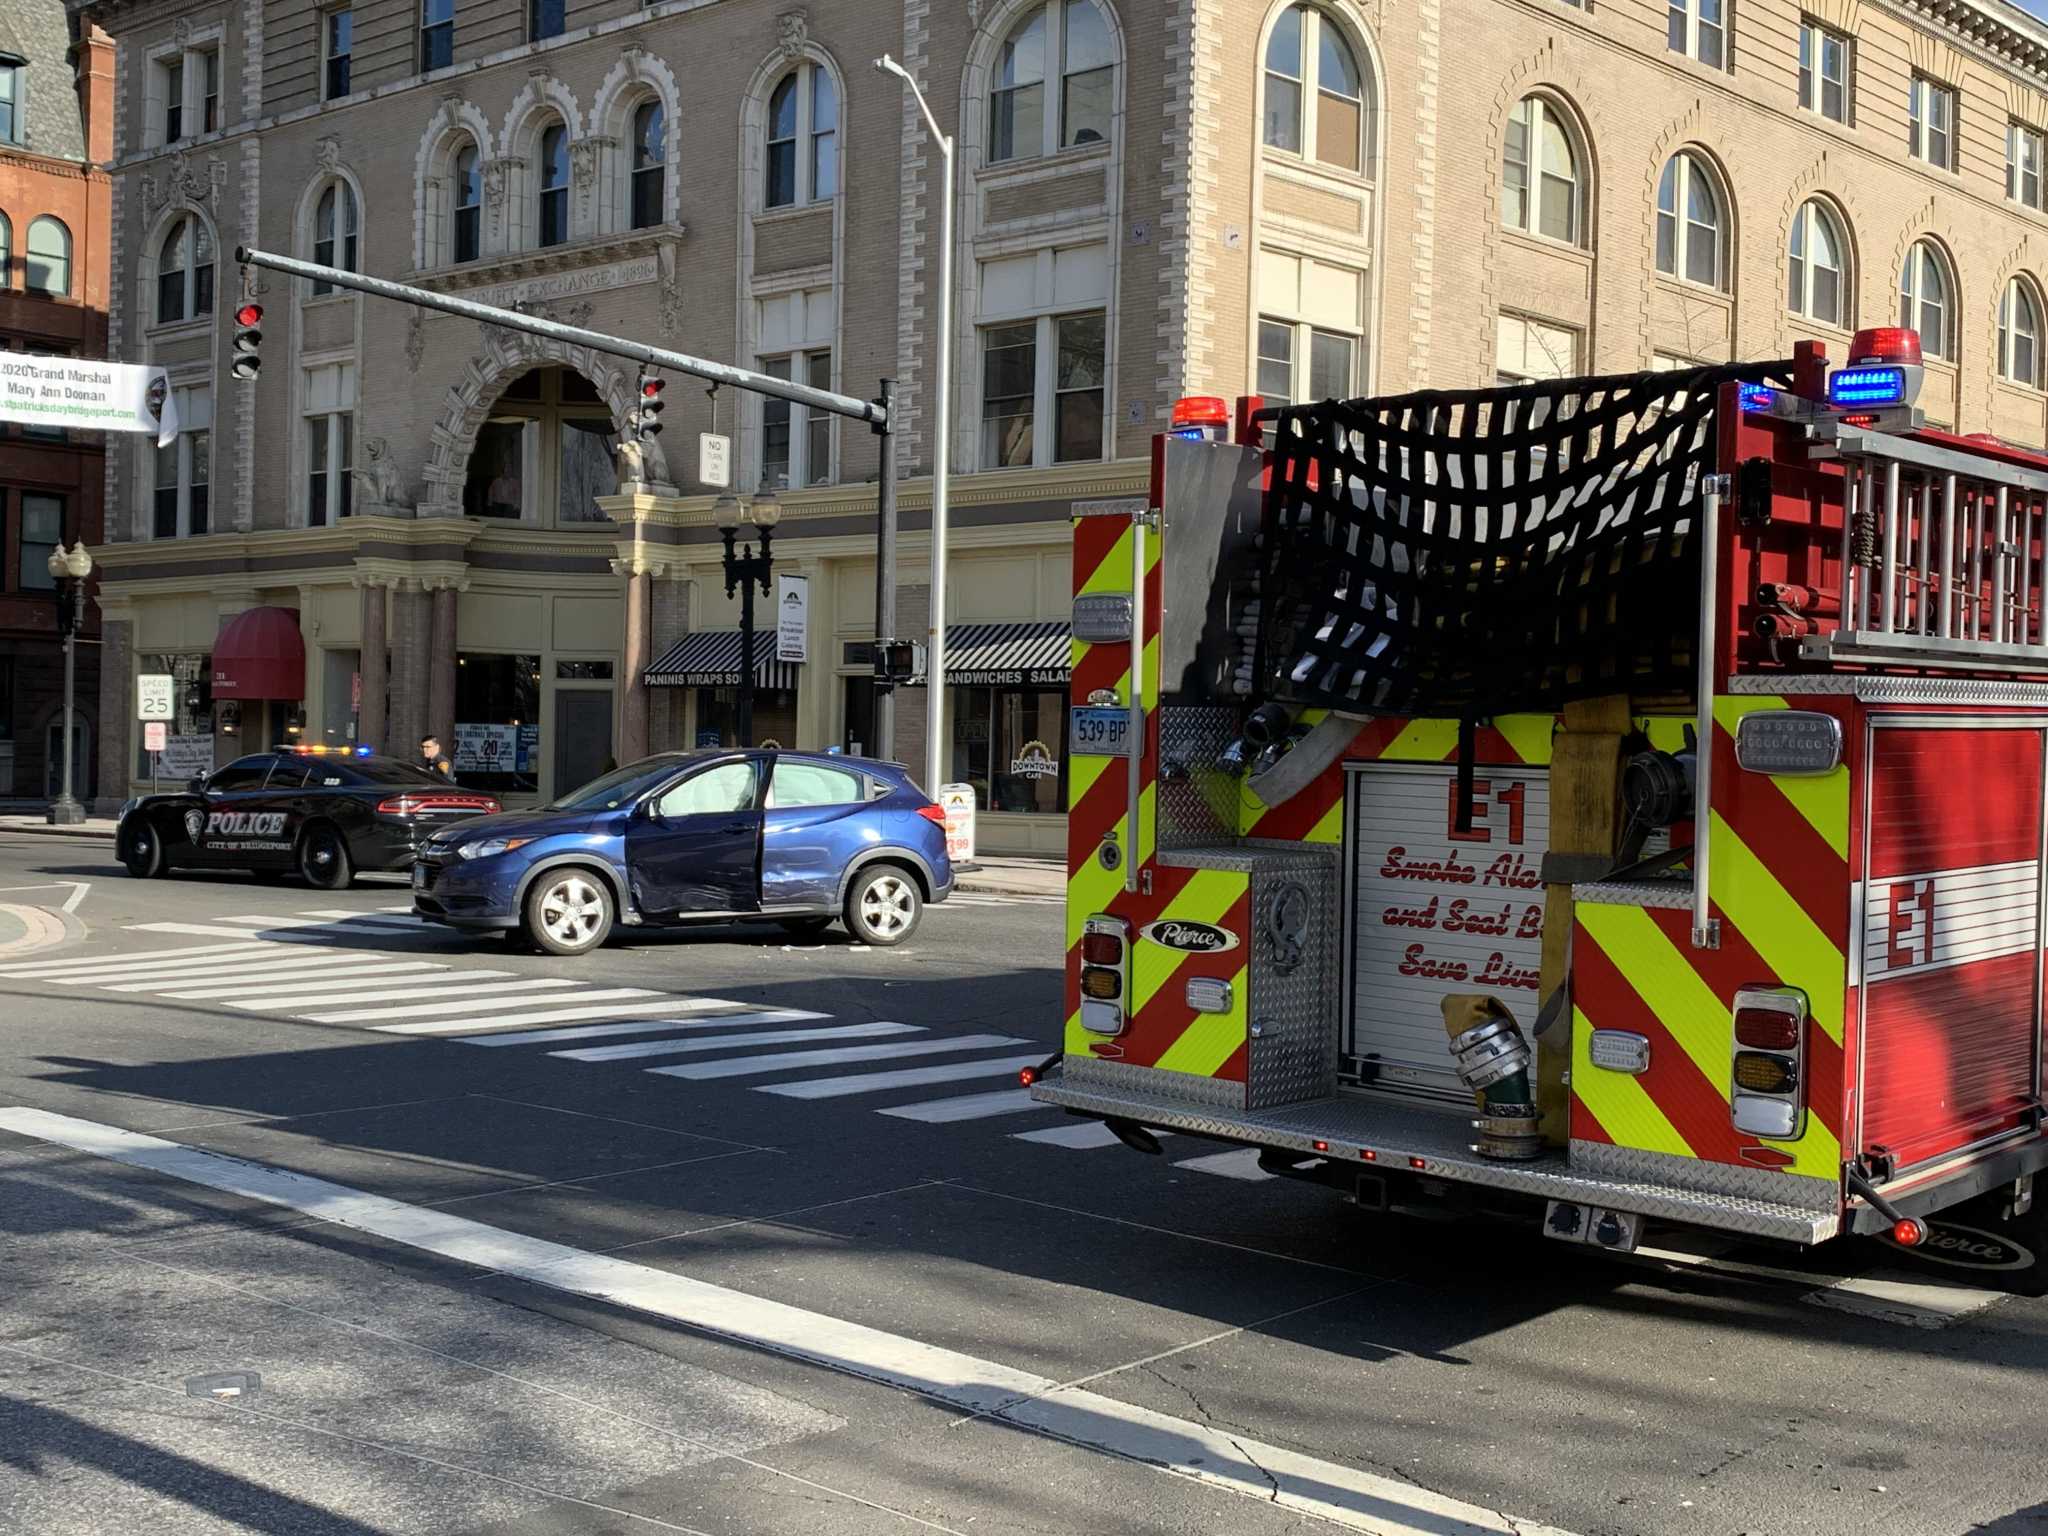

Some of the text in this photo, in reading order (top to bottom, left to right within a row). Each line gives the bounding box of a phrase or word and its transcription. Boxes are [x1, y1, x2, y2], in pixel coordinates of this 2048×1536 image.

[1, 363, 112, 385] 2020 Grand Marshal
[7, 382, 106, 402] Mary Ann Doonan
[708, 440, 721, 451] NO
[141, 679, 169, 688] SPEED
[644, 673, 685, 686] PANINIS
[687, 673, 723, 685] WRAPS
[143, 688, 165, 697] LIMIT
[143, 697, 168, 713] 25
[1012, 761, 1057, 773] DOWNTOWN
[1447, 778, 1525, 845] E1
[205, 812, 288, 836] POLICE
[206, 841, 225, 849] CITY
[240, 841, 292, 850] BRIDGEPORT
[1380, 846, 1476, 885] Smoke
[1382, 896, 1440, 930] and
[1442, 899, 1511, 937] Seat
[1887, 879, 1935, 969] E1
[1161, 922, 1216, 946] Pierce
[1398, 943, 1469, 982] Save
[1926, 1230, 2003, 1259] ierce
